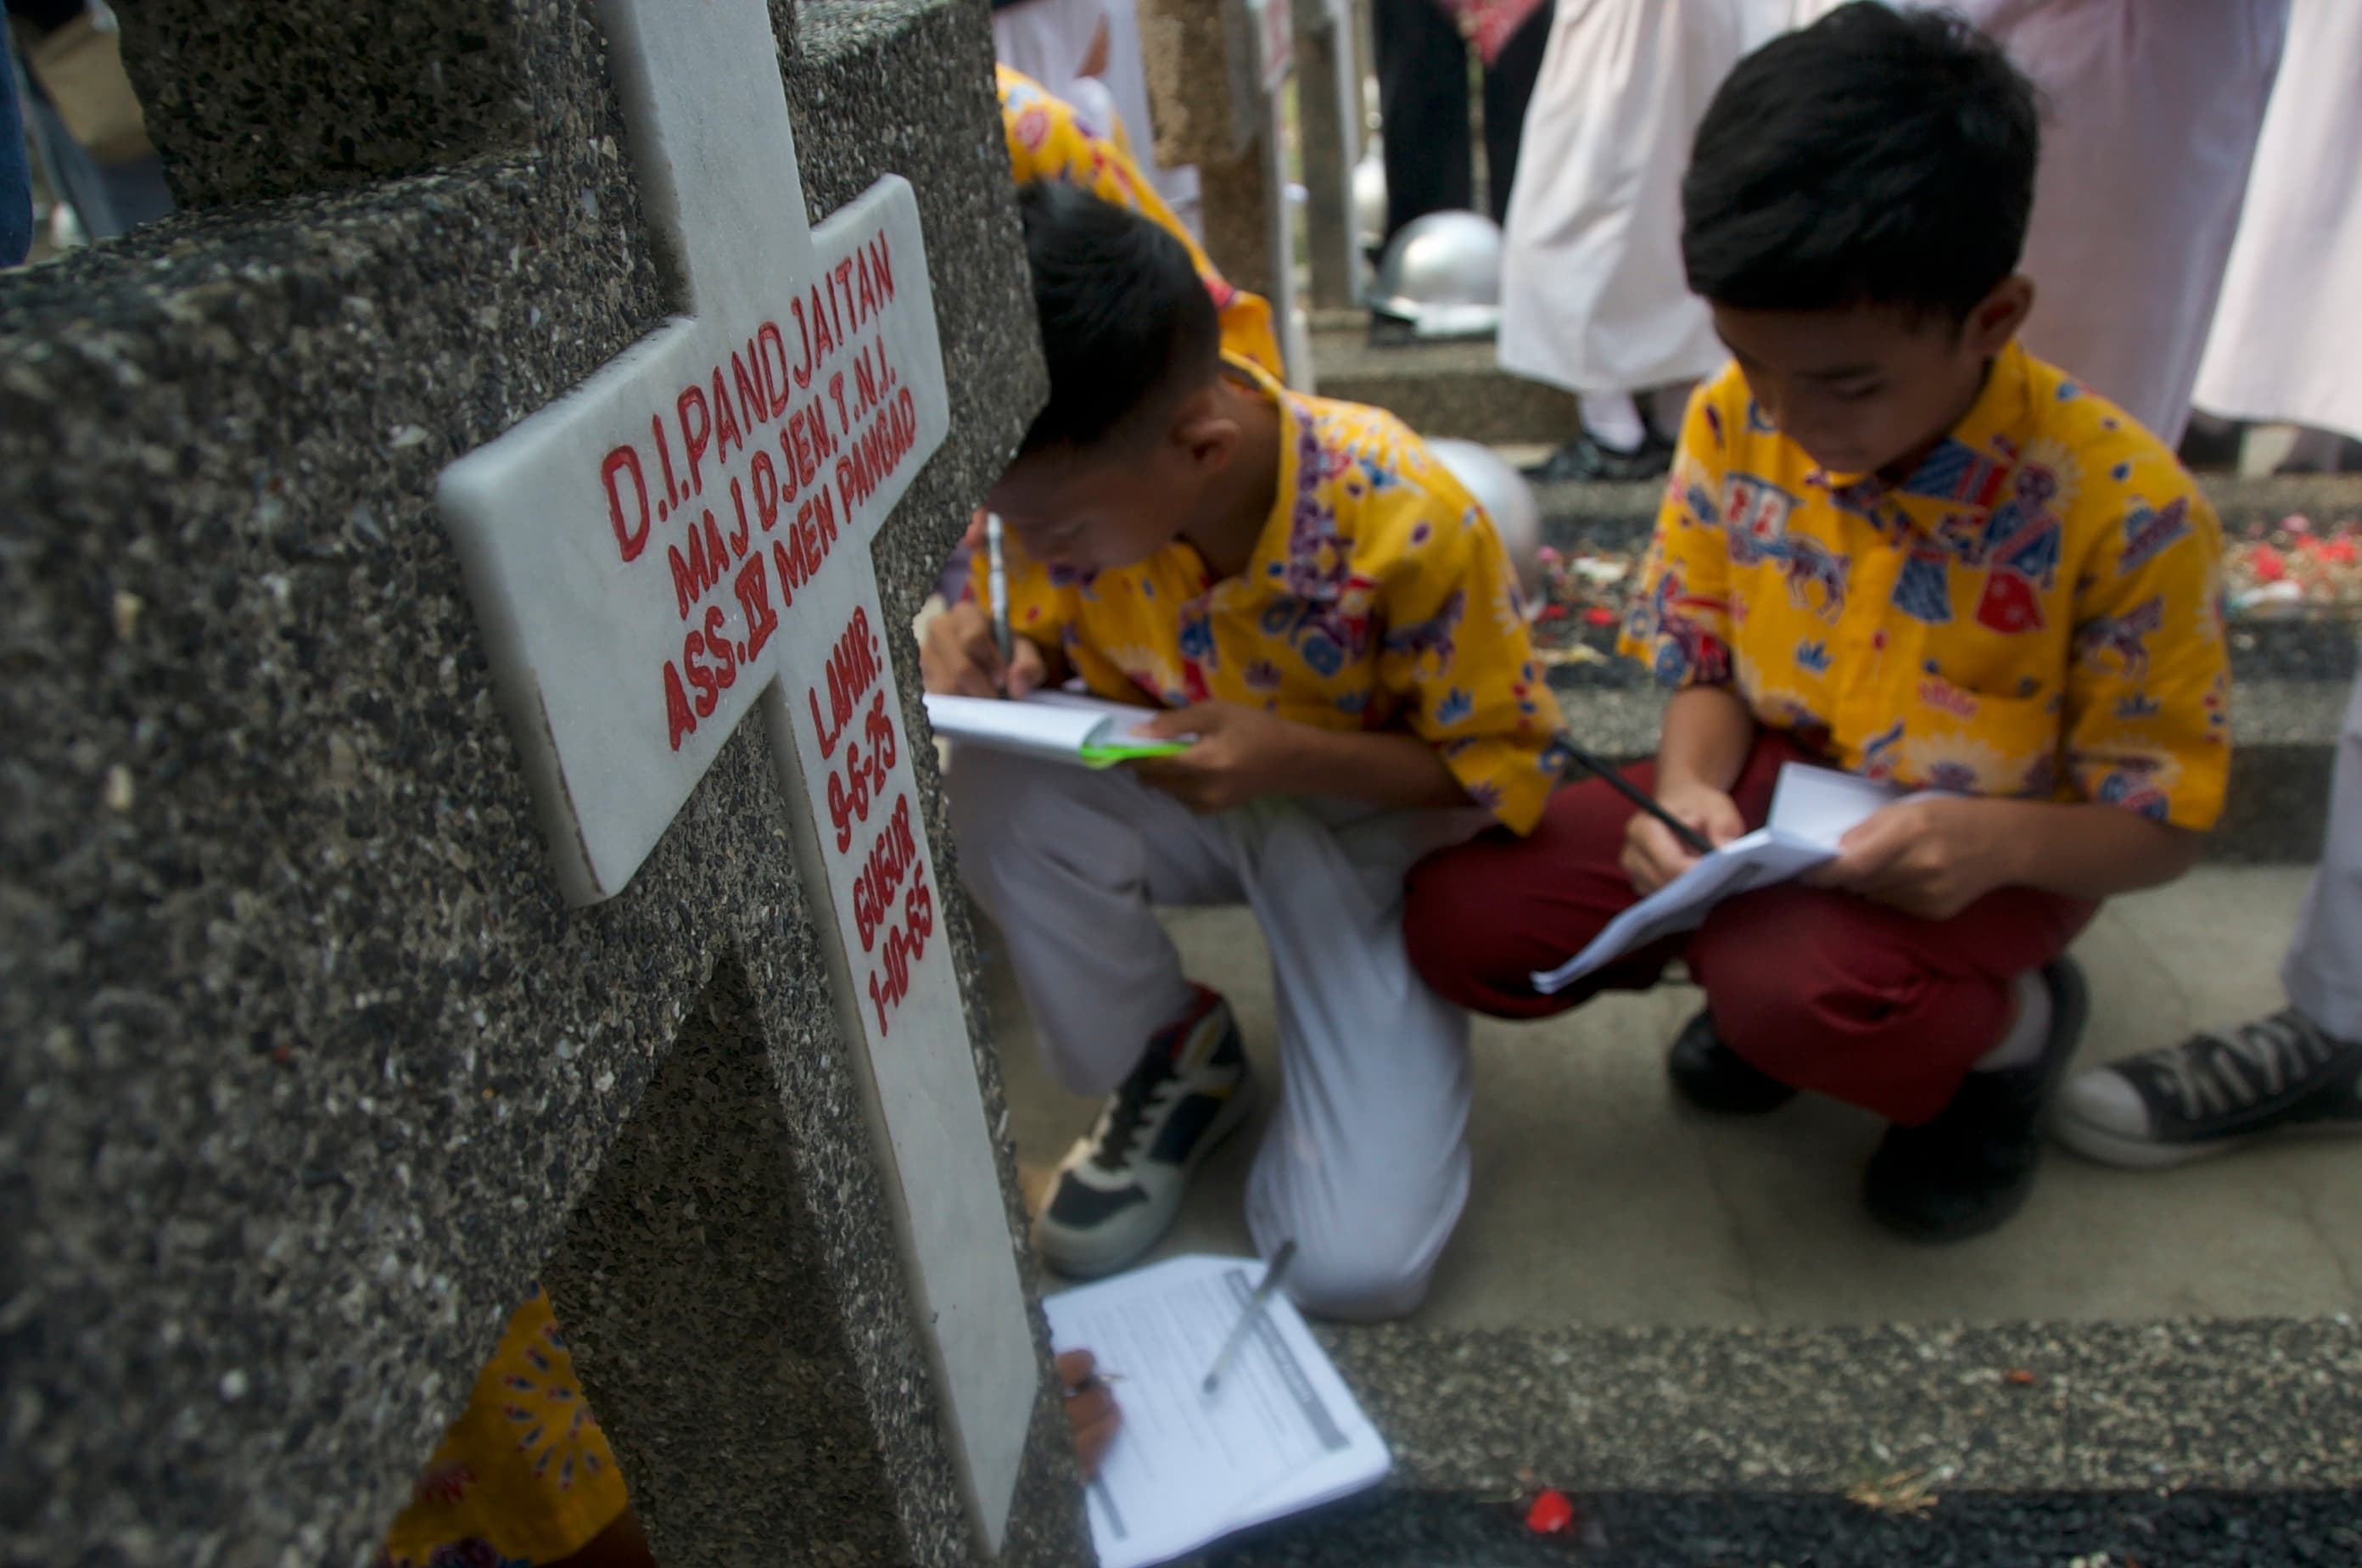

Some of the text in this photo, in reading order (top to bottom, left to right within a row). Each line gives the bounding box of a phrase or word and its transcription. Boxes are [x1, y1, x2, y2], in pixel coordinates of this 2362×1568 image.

[773, 483, 837, 608] MEN
[836, 386, 916, 524] PANGAD
[809, 605, 882, 760] LAHIR:
[827, 689, 896, 854] 9-6-25
[853, 793, 916, 953] GUGUR
[869, 860, 933, 1038] 1-10-65
